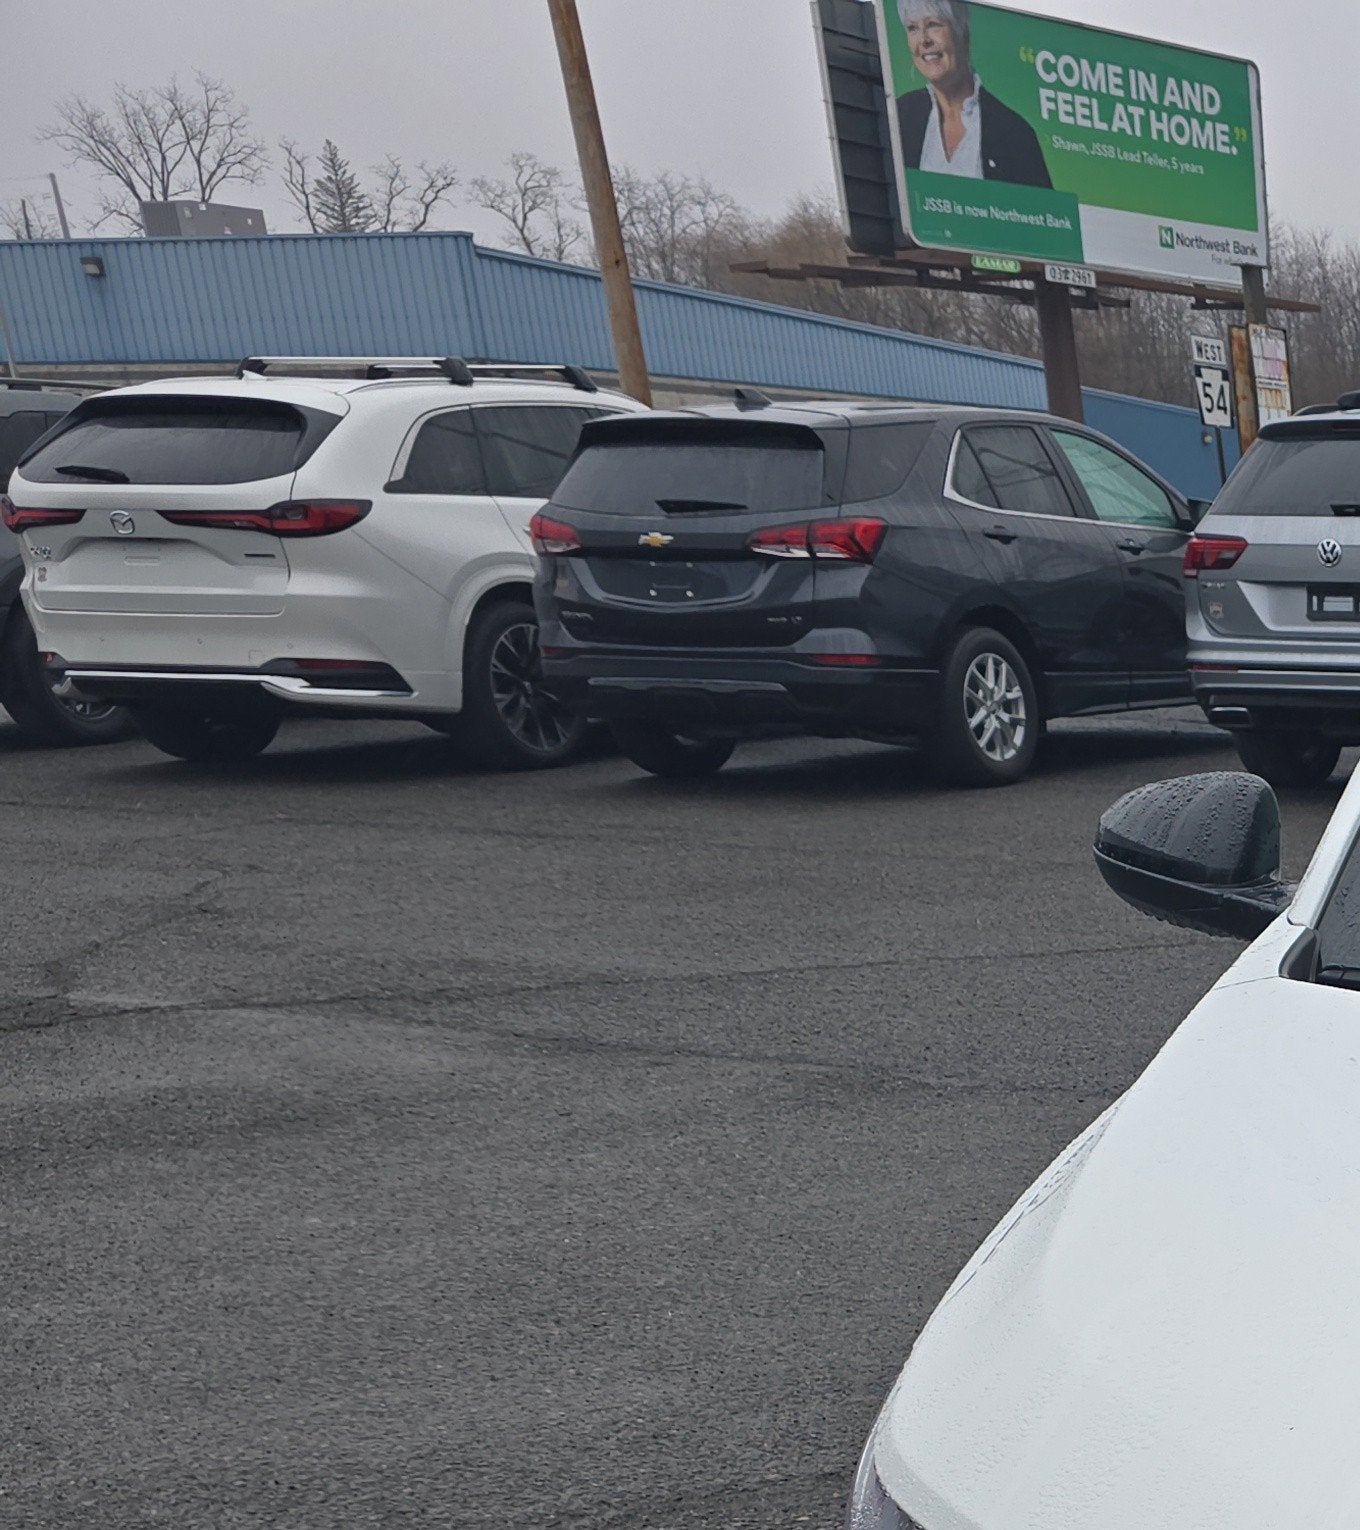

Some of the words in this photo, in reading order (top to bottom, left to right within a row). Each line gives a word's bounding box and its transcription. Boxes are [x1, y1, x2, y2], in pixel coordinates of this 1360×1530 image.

[1128, 69, 1158, 101] IN
[1163, 77, 1221, 115] AND
[1039, 88, 1109, 132] FEEL
[1111, 103, 1145, 137] AT
[1090, 142, 1115, 159] JSSB
[1117, 147, 1142, 163] Lead
[1179, 161, 1204, 174] years
[923, 197, 952, 213] JSSB
[953, 202, 964, 215] is
[964, 208, 988, 218] now
[989, 205, 1045, 227] Northwest
[1046, 213, 1072, 230] Bank
[1176, 232, 1231, 253] Northwest
[1233, 240, 1258, 257] Bank
[1195, 339, 1223, 362] WEST
[1202, 382, 1228, 415] 54
